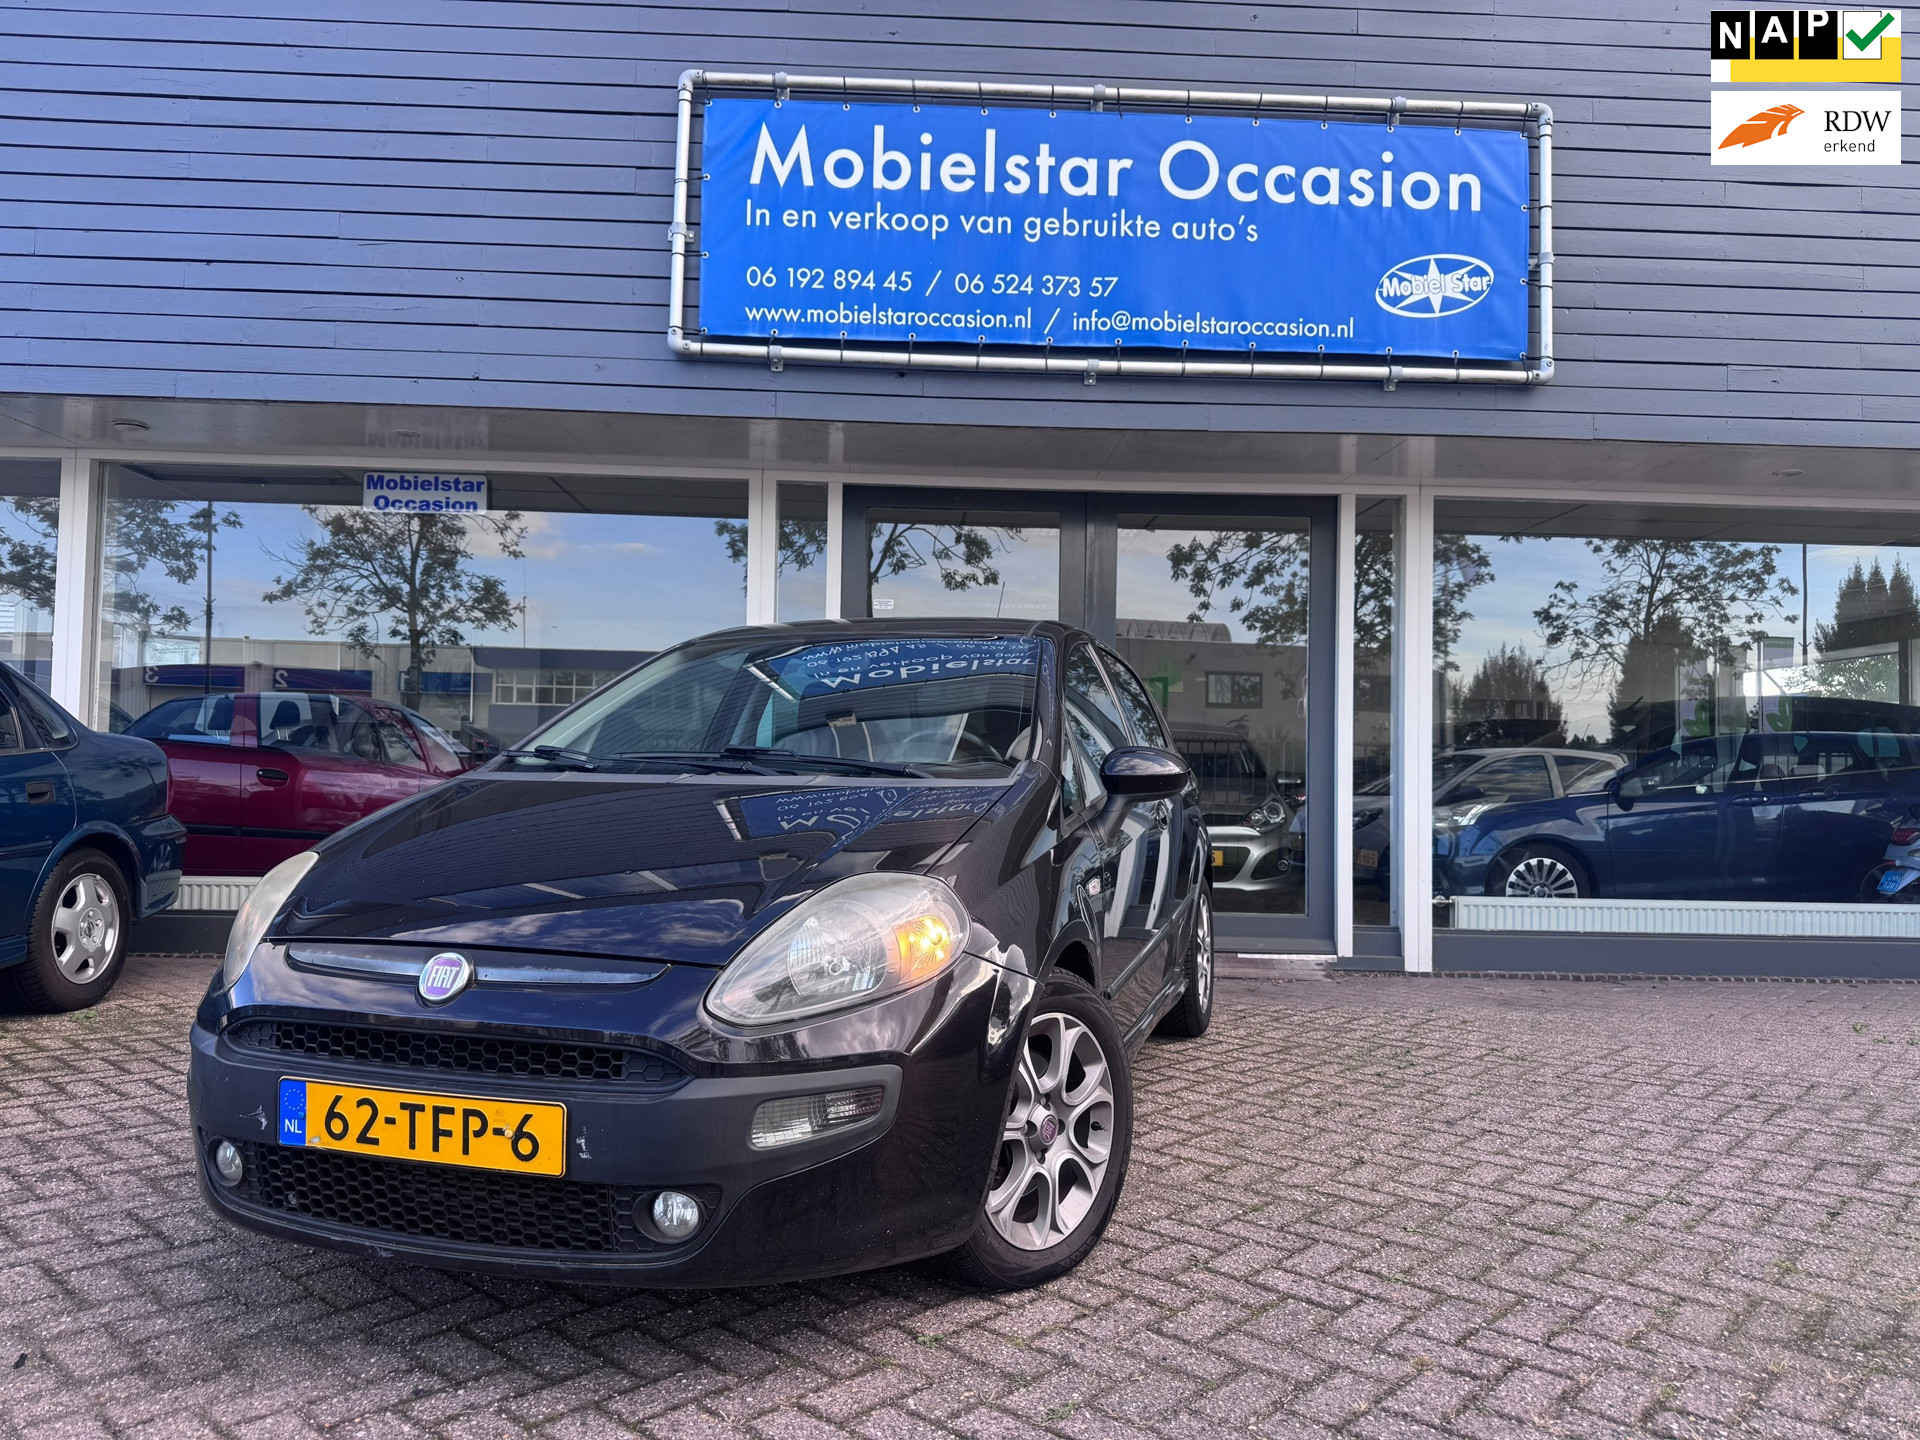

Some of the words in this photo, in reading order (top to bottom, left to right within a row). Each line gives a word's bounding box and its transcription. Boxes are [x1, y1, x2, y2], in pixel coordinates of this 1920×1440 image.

[749, 122, 1133, 197] Mobielstar
[1159, 139, 1482, 212] Occasion
[746, 199, 770, 226] In
[782, 209, 817, 228] en
[828, 201, 949, 240] verkoop
[959, 215, 1012, 234] van
[1023, 207, 1161, 243] gebruikte
[745, 266, 777, 288] 06
[786, 267, 825, 289] 192
[833, 269, 876, 290] 894
[882, 270, 912, 292] 45
[925, 269, 942, 297] /
[954, 272, 985, 294] 06
[991, 273, 1034, 296] 524
[1041, 274, 1081, 297] 373
[1088, 276, 1119, 298] 57
[1382, 273, 1447, 298] Mobiel
[1450, 272, 1491, 294] Star
[745, 302, 1032, 330] www.mobielstaroccasion.nl
[1043, 307, 1061, 335] /
[1072, 309, 1354, 339] info@mobielstaroccasion.nl
[366, 474, 486, 493] Mobielstar
[373, 494, 478, 513] Occasion
[427, 965, 460, 989] FIAT
[284, 1117, 303, 1134] NL
[323, 1094, 540, 1162] 62-TFP-6
